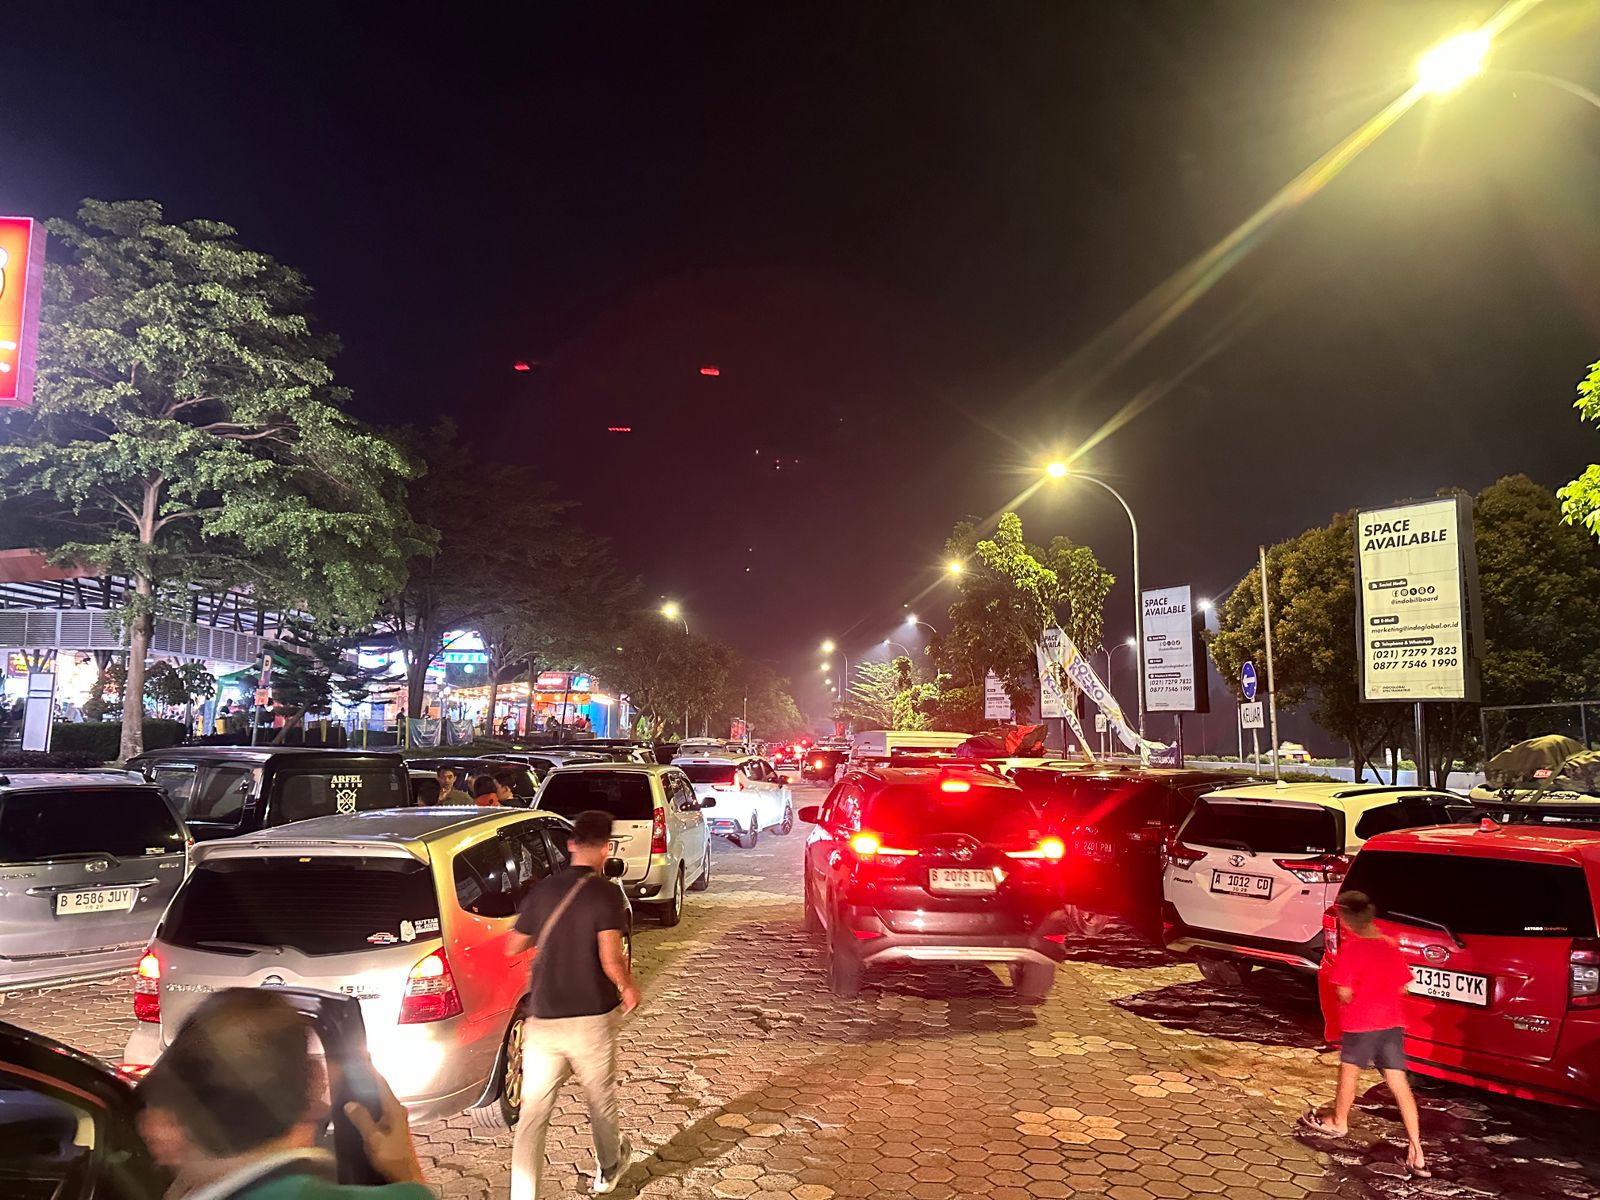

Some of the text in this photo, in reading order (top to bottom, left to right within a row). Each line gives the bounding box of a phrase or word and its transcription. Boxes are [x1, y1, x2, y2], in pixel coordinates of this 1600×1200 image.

[1364, 519, 1410, 536] SPACE
[1364, 529, 1447, 551] AVAILABLE
[1144, 597, 1168, 607] SPACE
[1391, 595, 1438, 605] @indobillboard
[1145, 605, 1186, 616] AVAILABLE
[1373, 646, 1457, 660] (021) 7279 7823
[1373, 658, 1458, 670] 0877 7546 1990
[331, 775, 363, 783] ARFEL
[932, 870, 938, 881] B
[1215, 874, 1269, 890] A 1012 CD
[61, 891, 128, 907] B 2586 JUY
[1416, 969, 1483, 996] 1315 CYK
